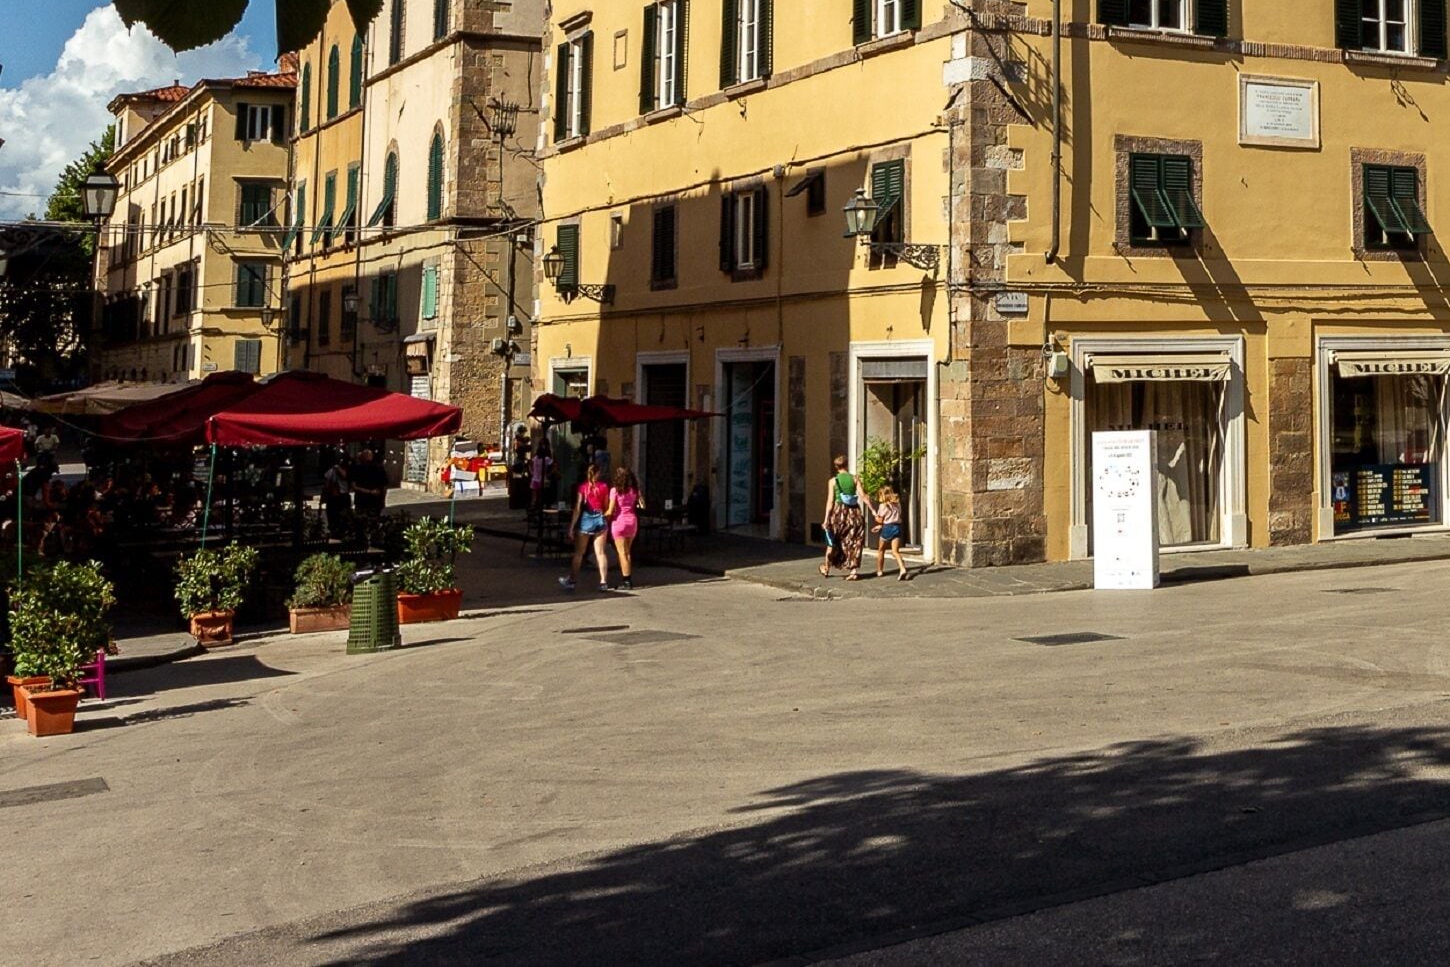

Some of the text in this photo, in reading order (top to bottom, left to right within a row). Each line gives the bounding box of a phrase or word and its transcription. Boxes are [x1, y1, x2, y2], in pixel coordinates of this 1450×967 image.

[1353, 363, 1444, 373] MICHEL
[1110, 369, 1219, 379] MICHEL
[1108, 422, 1189, 431] MIHEL
